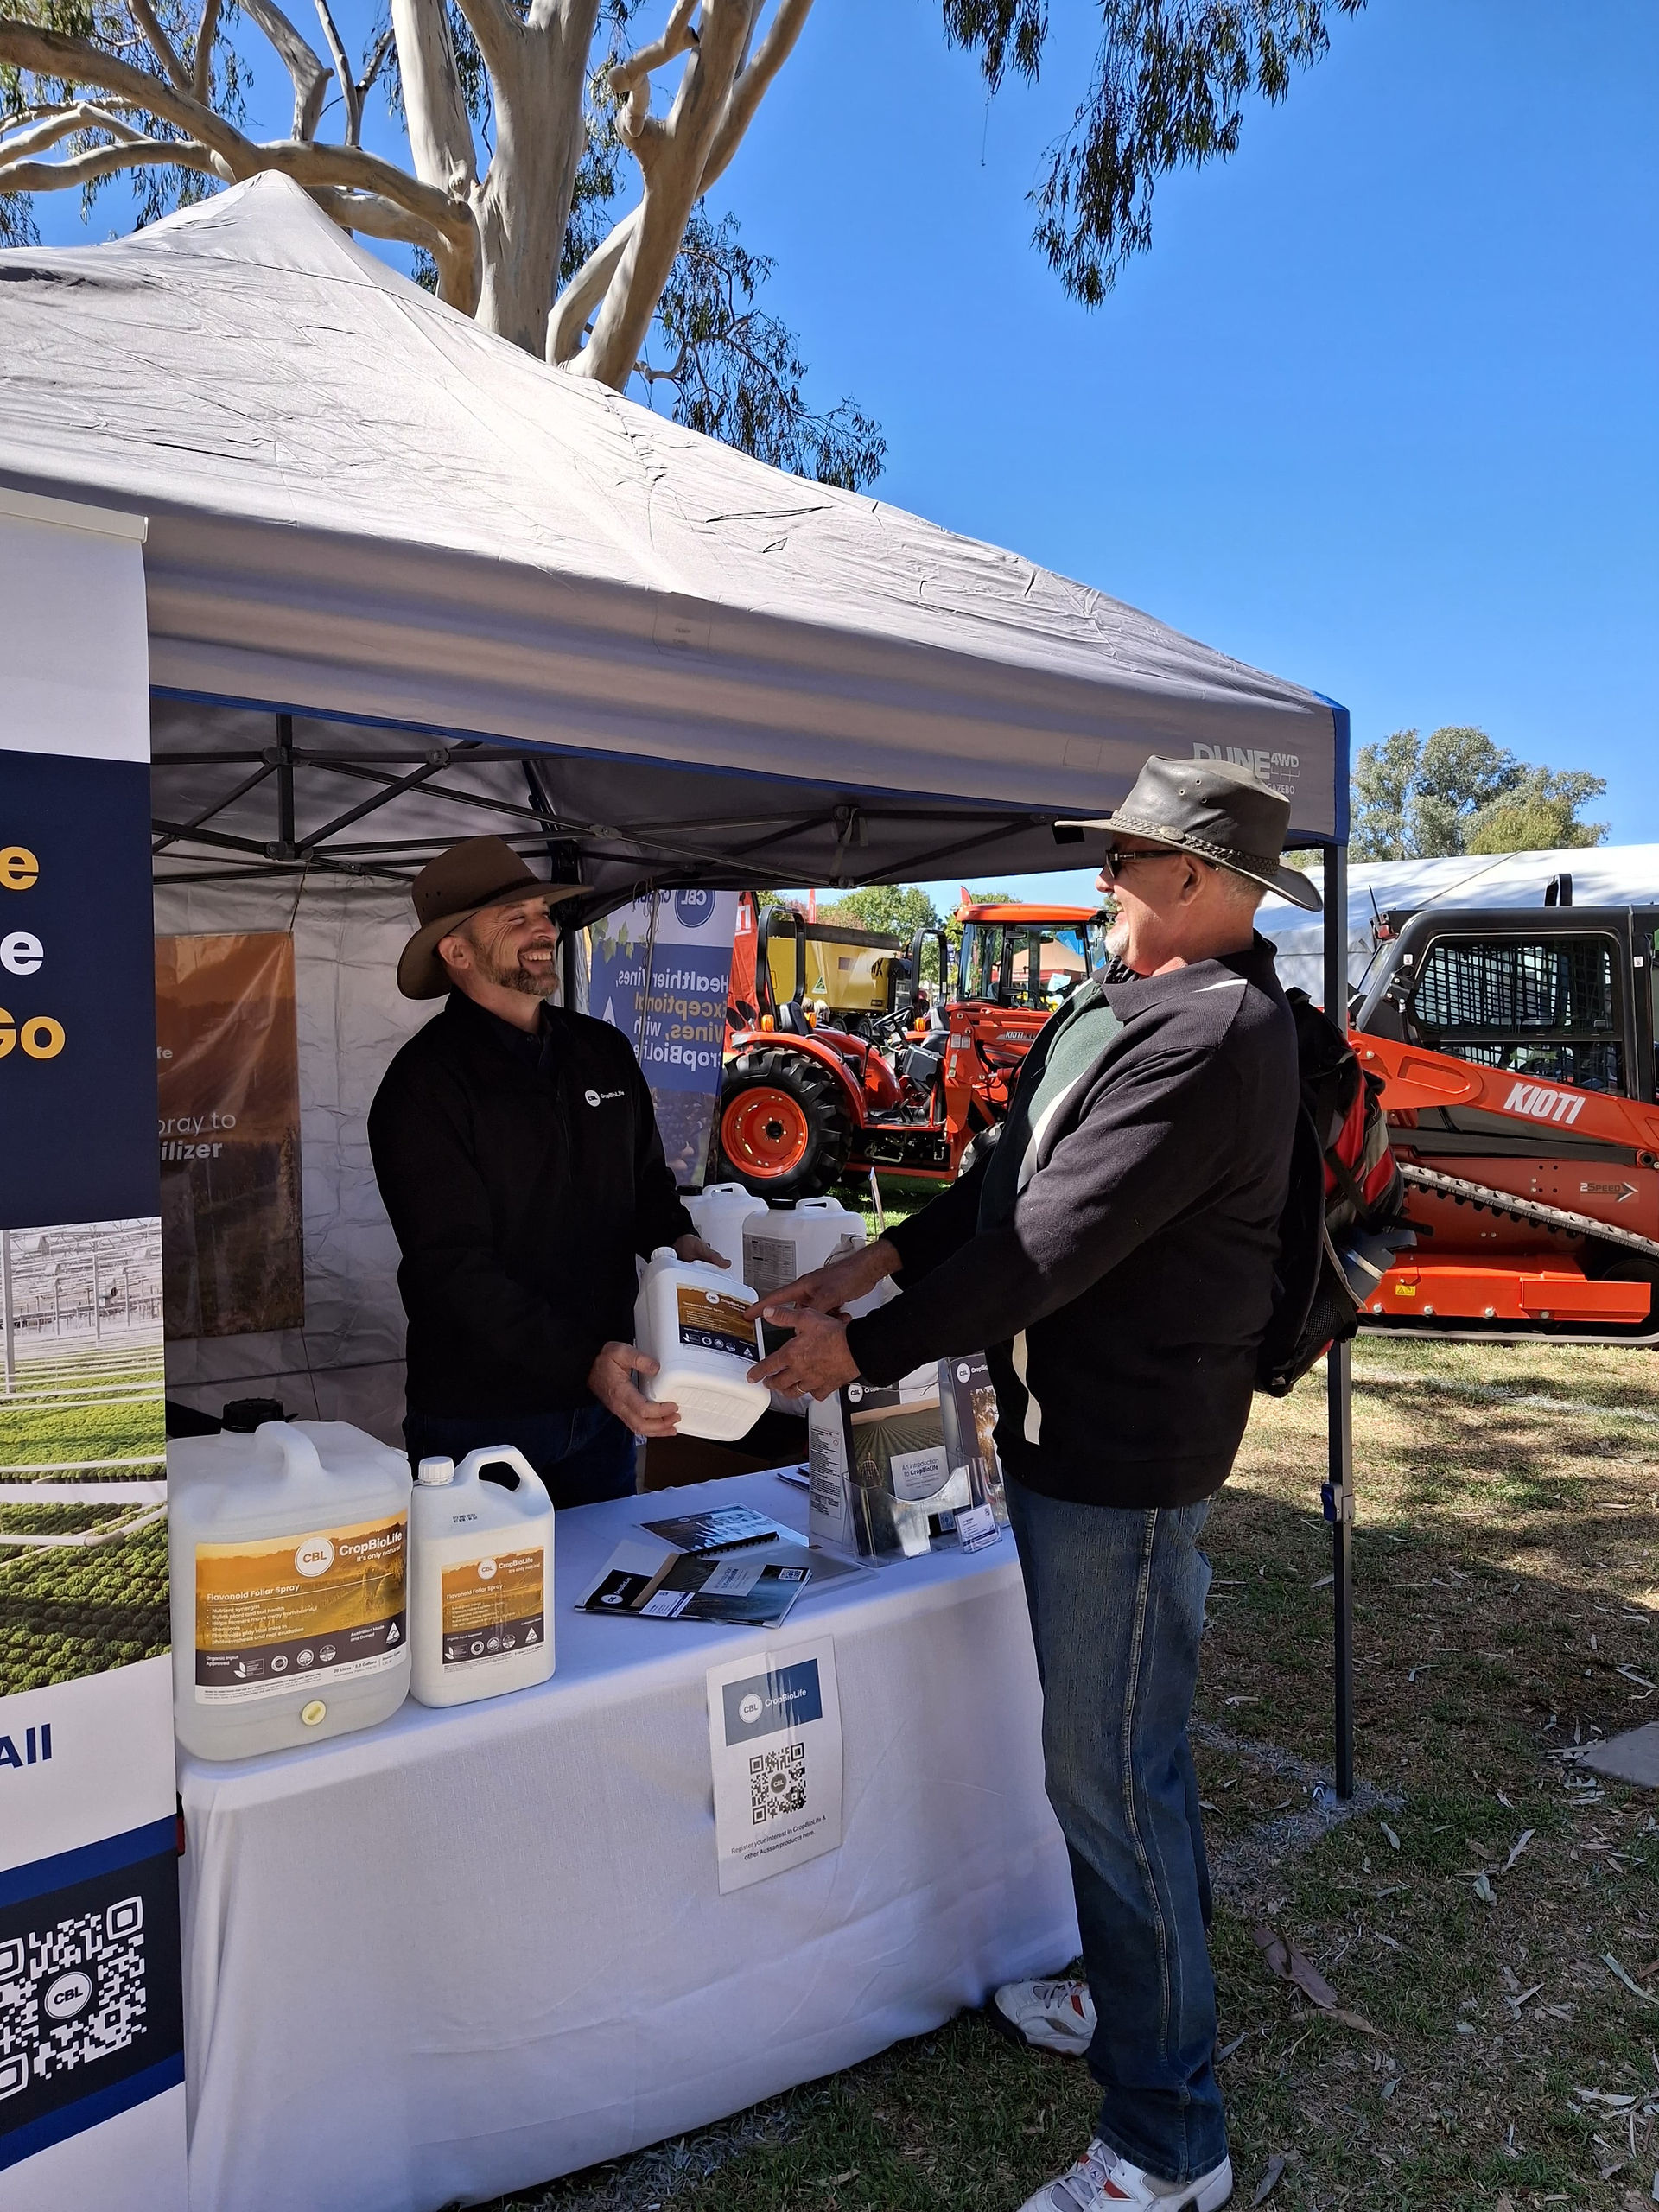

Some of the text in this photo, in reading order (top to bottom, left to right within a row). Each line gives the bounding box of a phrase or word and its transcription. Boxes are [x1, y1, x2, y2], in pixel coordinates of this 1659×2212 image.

[1270, 753, 1300, 767] 4WD
[1005, 1031, 1024, 1039] KIOTI
[1503, 1082, 1586, 1125] KIOTI
[211, 1110, 237, 1129] to
[339, 1531, 403, 1556] CropBioLife
[303, 1551, 327, 1563] CBL
[367, 1551, 382, 1560] only
[383, 1545, 402, 1557] natural
[499, 1557, 534, 1570] CropBioLife
[207, 1584, 300, 1601] Flavonoid Foliar Spray
[765, 1689, 807, 1707] CropBioLife
[744, 1704, 759, 1714] CBL
[731, 1843, 754, 1854] Register
[753, 1839, 766, 1848] your
[766, 1830, 787, 1842] interest
[793, 1817, 822, 1833] CropBioLife
[744, 1851, 760, 1861] other
[779, 1834, 803, 1849] products
[803, 1830, 816, 1839] here.
[54, 1986, 84, 2005] CBL
